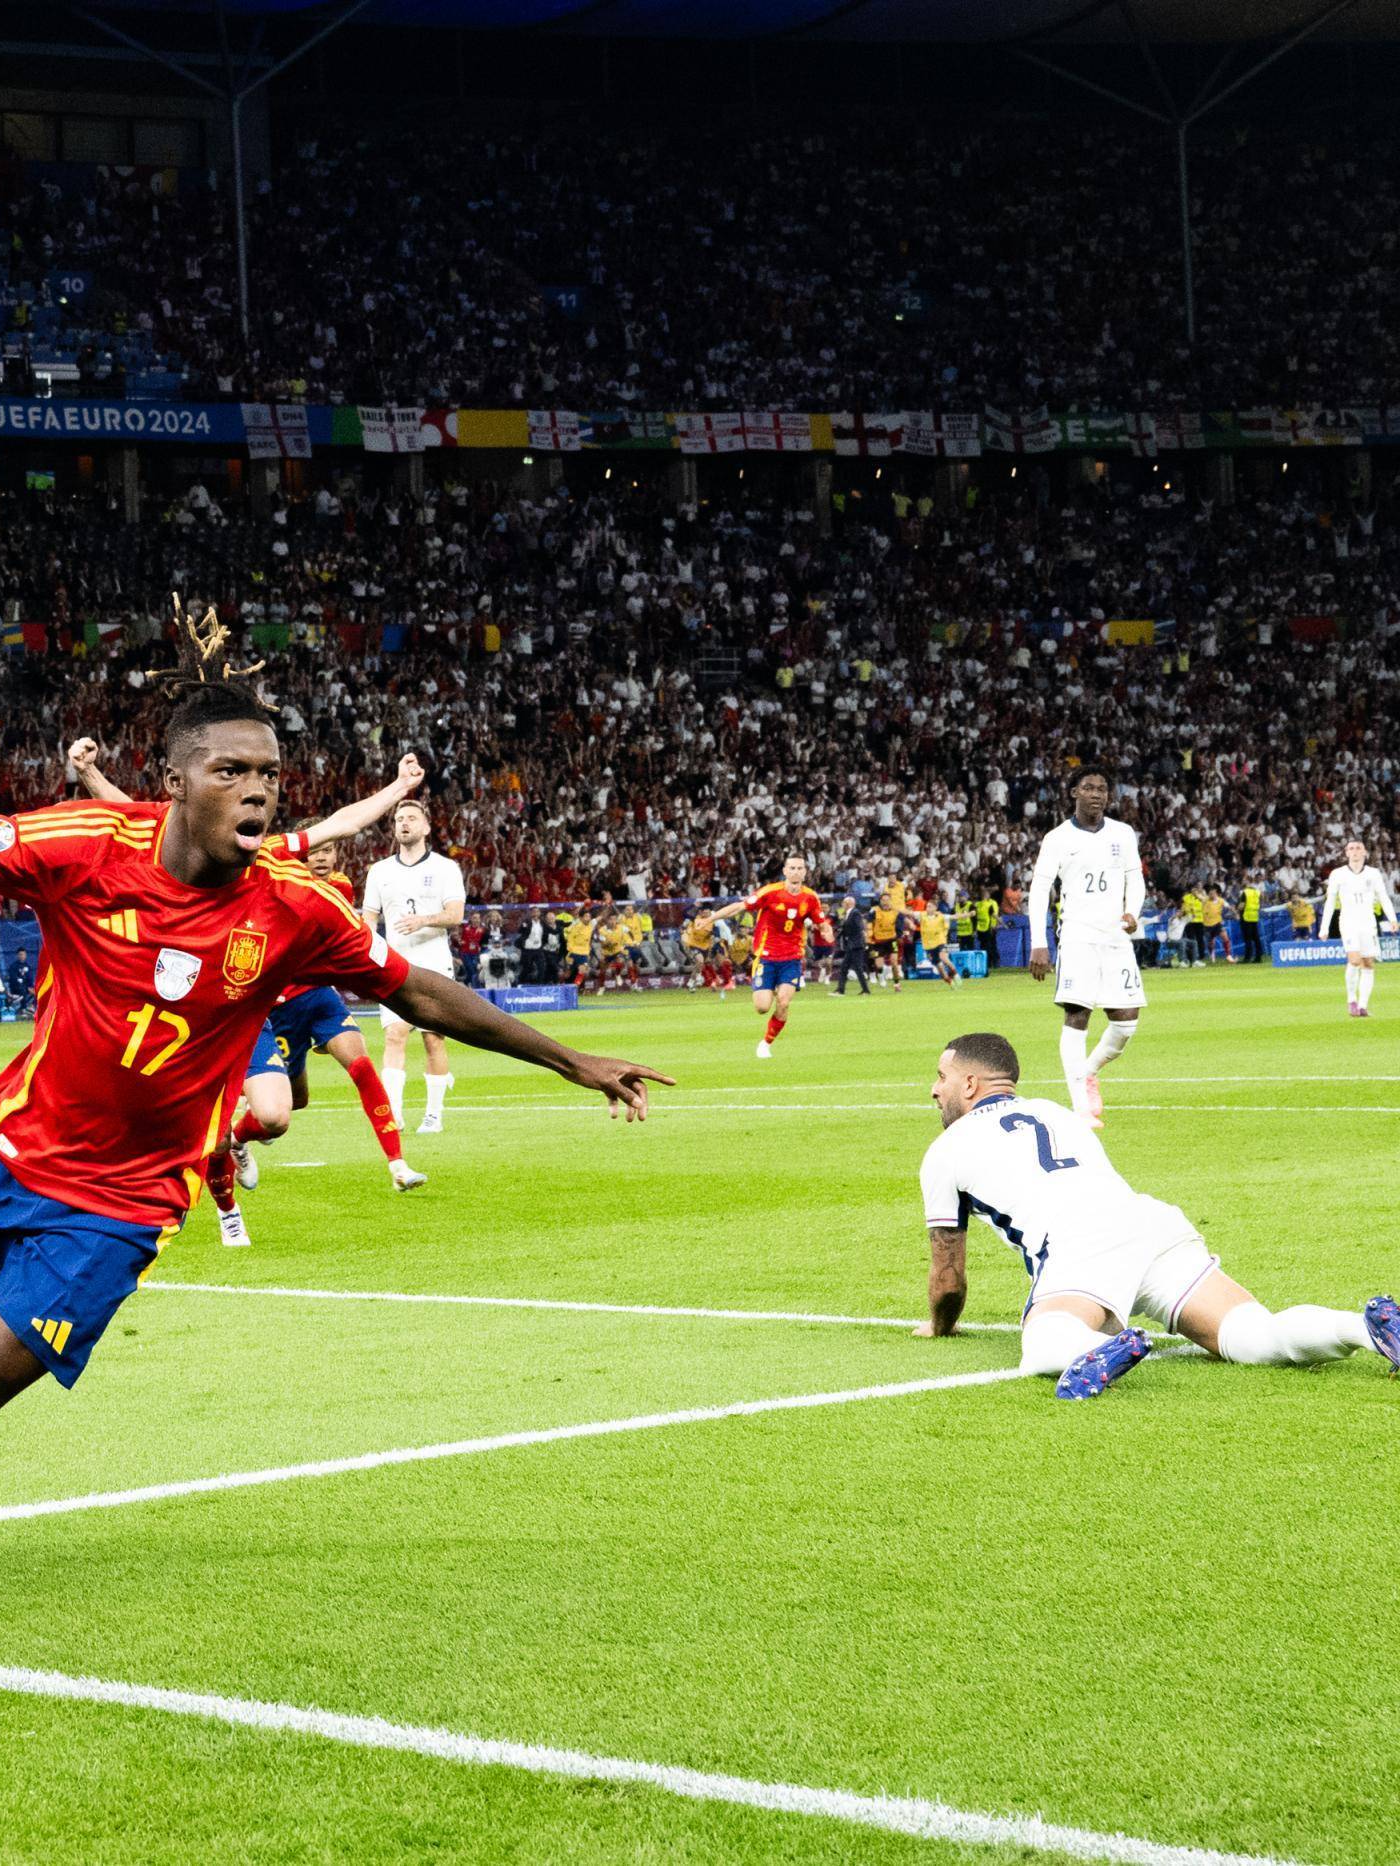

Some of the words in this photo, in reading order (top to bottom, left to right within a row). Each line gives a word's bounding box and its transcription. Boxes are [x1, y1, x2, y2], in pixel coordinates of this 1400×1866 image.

[60, 277, 85, 293] 10
[558, 293, 577, 308] 11
[1085, 871, 1107, 893] 26
[407, 898, 416, 915] 3
[1354, 893, 1364, 904] 11
[784, 920, 794, 932] 8
[120, 1003, 190, 1076] 17
[1000, 1112, 1080, 1173] 2
